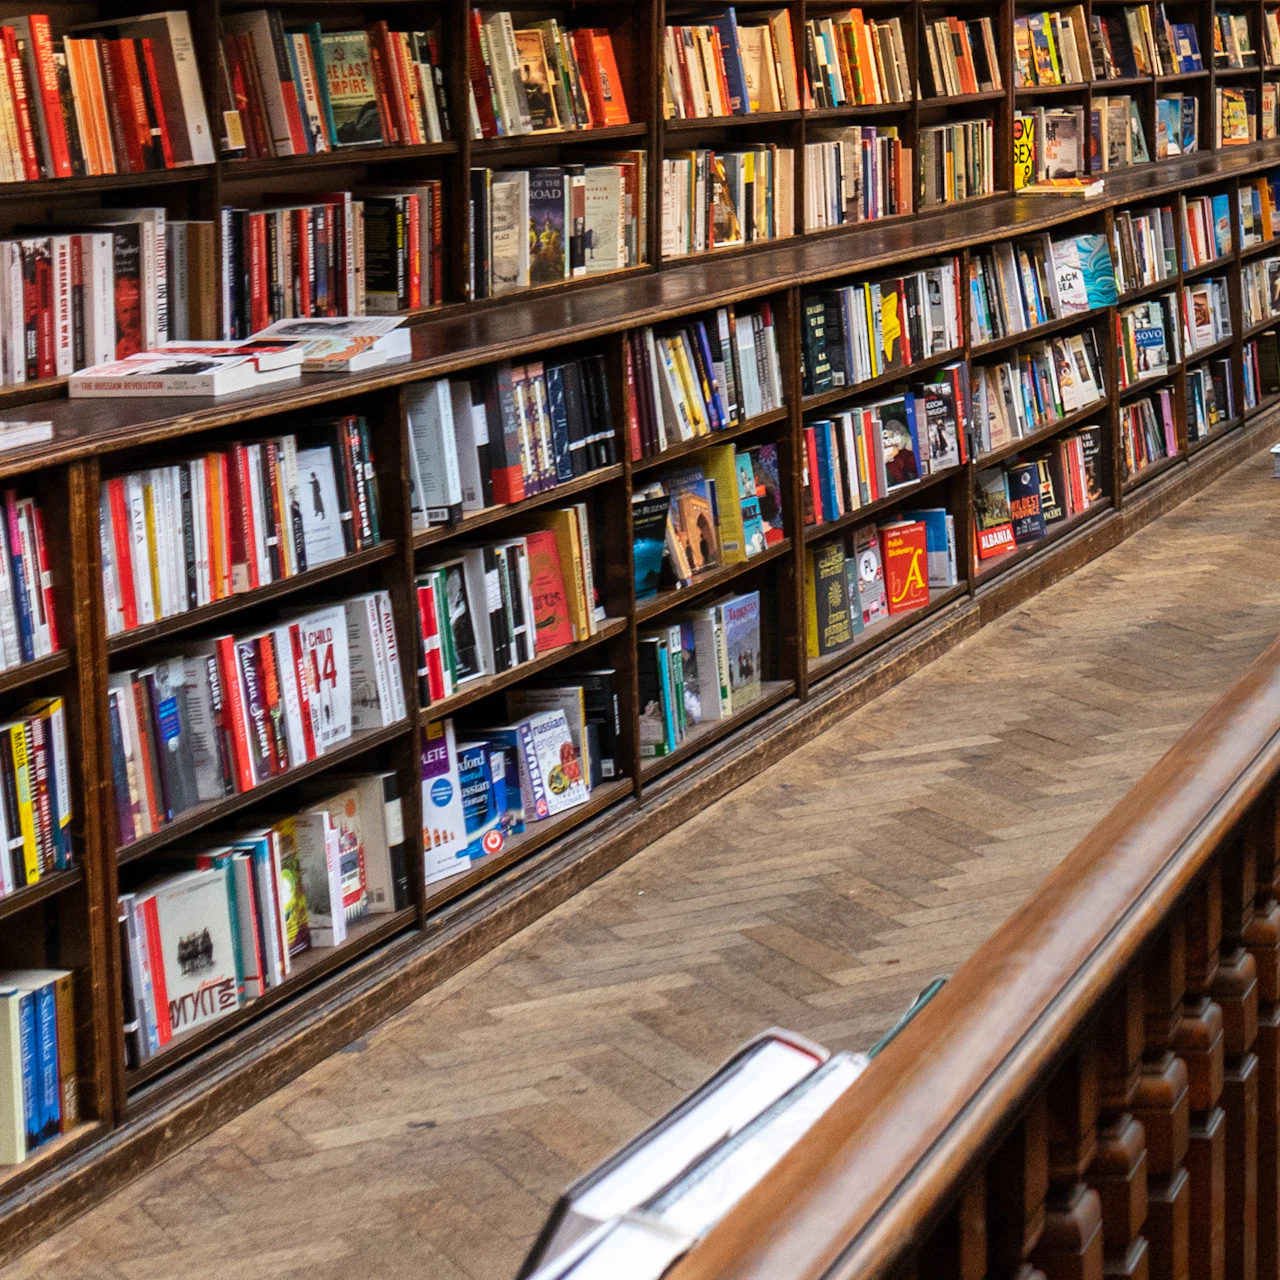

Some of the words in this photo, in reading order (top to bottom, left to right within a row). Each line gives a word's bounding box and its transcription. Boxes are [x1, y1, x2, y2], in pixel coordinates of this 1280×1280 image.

[11, 58, 27, 99] RUSSIA
[326, 66, 340, 79] HE
[341, 62, 370, 78] LAST
[529, 189, 561, 199] ROAD
[58, 251, 69, 297] RUSSIAN
[60, 298, 69, 324] CIVIL
[157, 299, 168, 333] LENIN
[61, 325, 69, 349] WAR
[81, 382, 93, 390] THE
[95, 382, 122, 390] RUSSIAN
[123, 382, 163, 390] REVOLUTION
[1011, 494, 1039, 511] WILDEST
[1012, 504, 1040, 520] PROVINCE
[132, 498, 144, 545] LARA
[887, 538, 904, 548] Polish
[980, 529, 1014, 551] ALBANIA
[888, 546, 915, 558] Dictionary
[308, 628, 334, 648] CHILD
[383, 612, 396, 649] AGENT
[206, 658, 222, 712] BEQUEST
[532, 717, 566, 736] russian
[536, 728, 569, 750] english
[14, 732, 27, 769] MASHA
[524, 733, 543, 798] VISUAL
